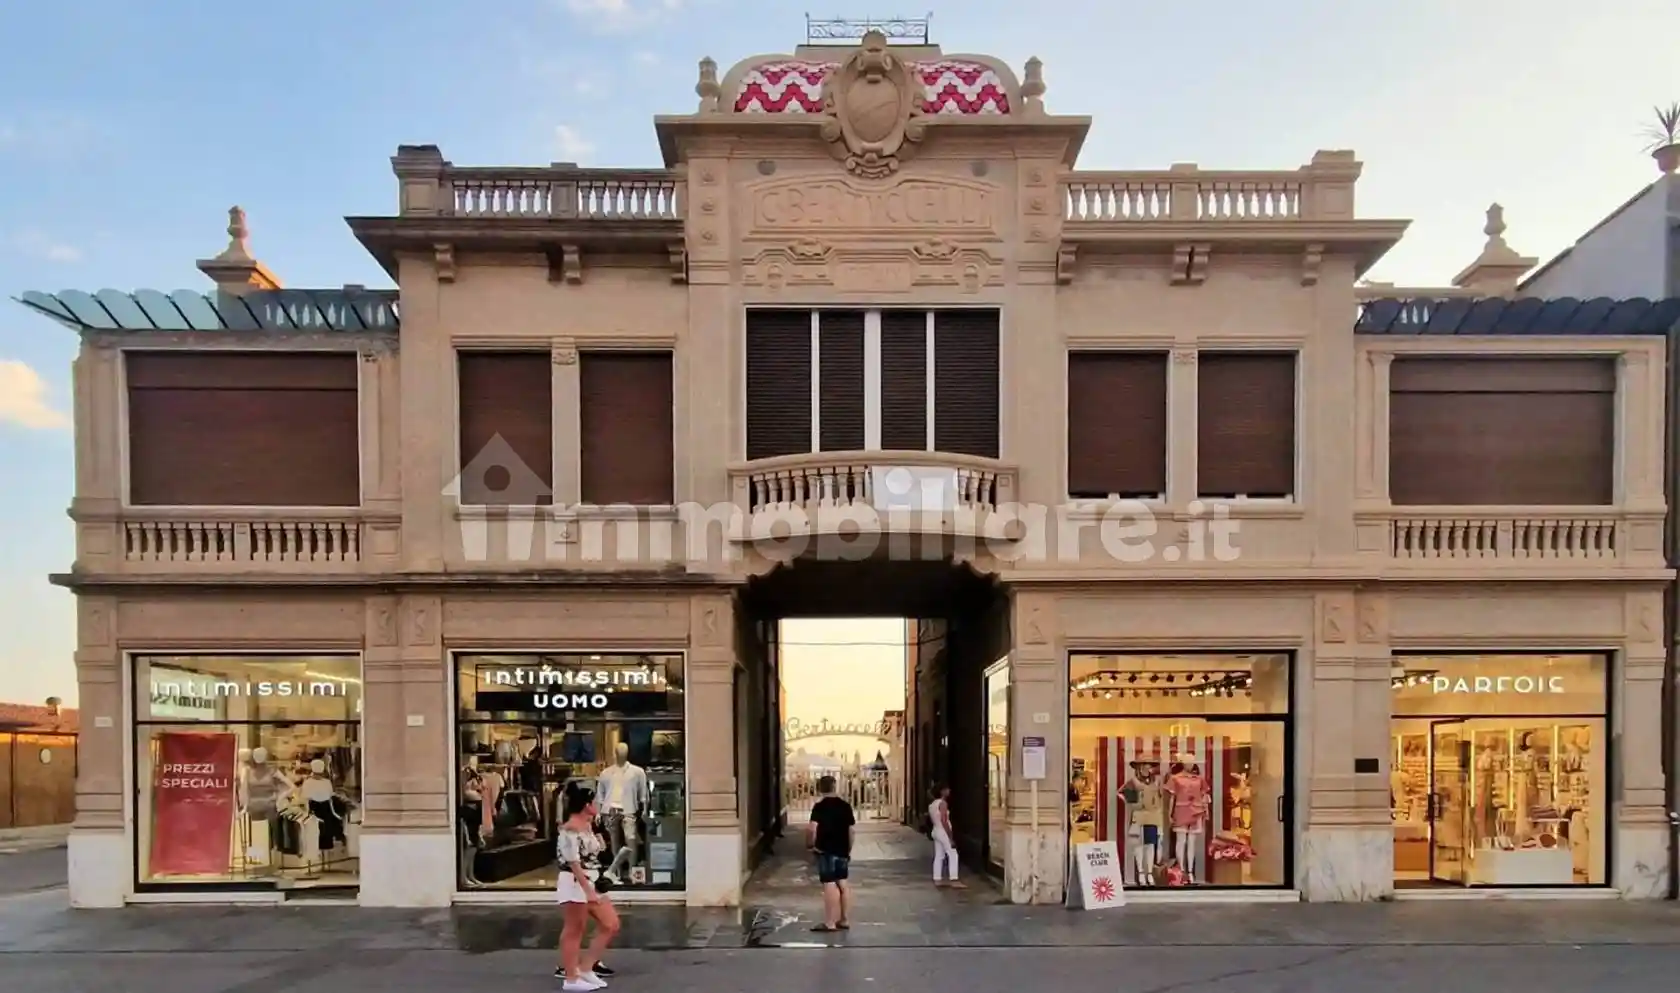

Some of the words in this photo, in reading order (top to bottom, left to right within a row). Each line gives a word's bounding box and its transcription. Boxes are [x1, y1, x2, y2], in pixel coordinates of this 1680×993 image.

[485, 669, 658, 685] intimissimi
[1433, 676, 1565, 693] PARFOIS
[153, 680, 347, 697] intimissimi
[533, 693, 608, 709] UOMO
[163, 763, 215, 774] PREZZI
[161, 778, 228, 789] SPECIALI
